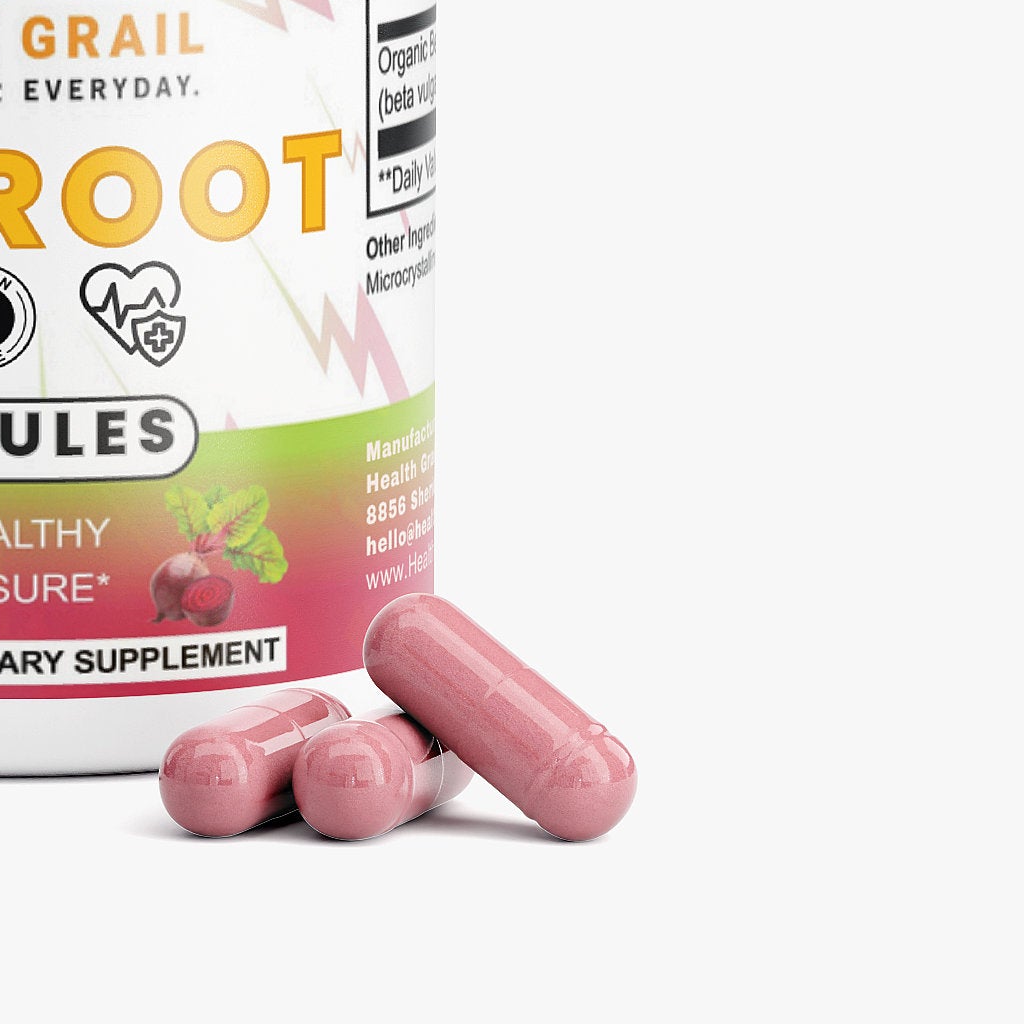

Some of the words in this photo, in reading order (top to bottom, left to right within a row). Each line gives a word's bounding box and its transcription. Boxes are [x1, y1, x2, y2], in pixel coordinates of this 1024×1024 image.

[21, 12, 204, 59] GRAIL
[378, 36, 428, 78] Organic
[23, 74, 199, 101] EVERYDAY.
[378, 84, 414, 124] (beta
[366, 233, 405, 261] Other
[366, 457, 417, 494] Health
[366, 495, 406, 525] 8856
[74, 636, 281, 675] SUPPLEMENT
